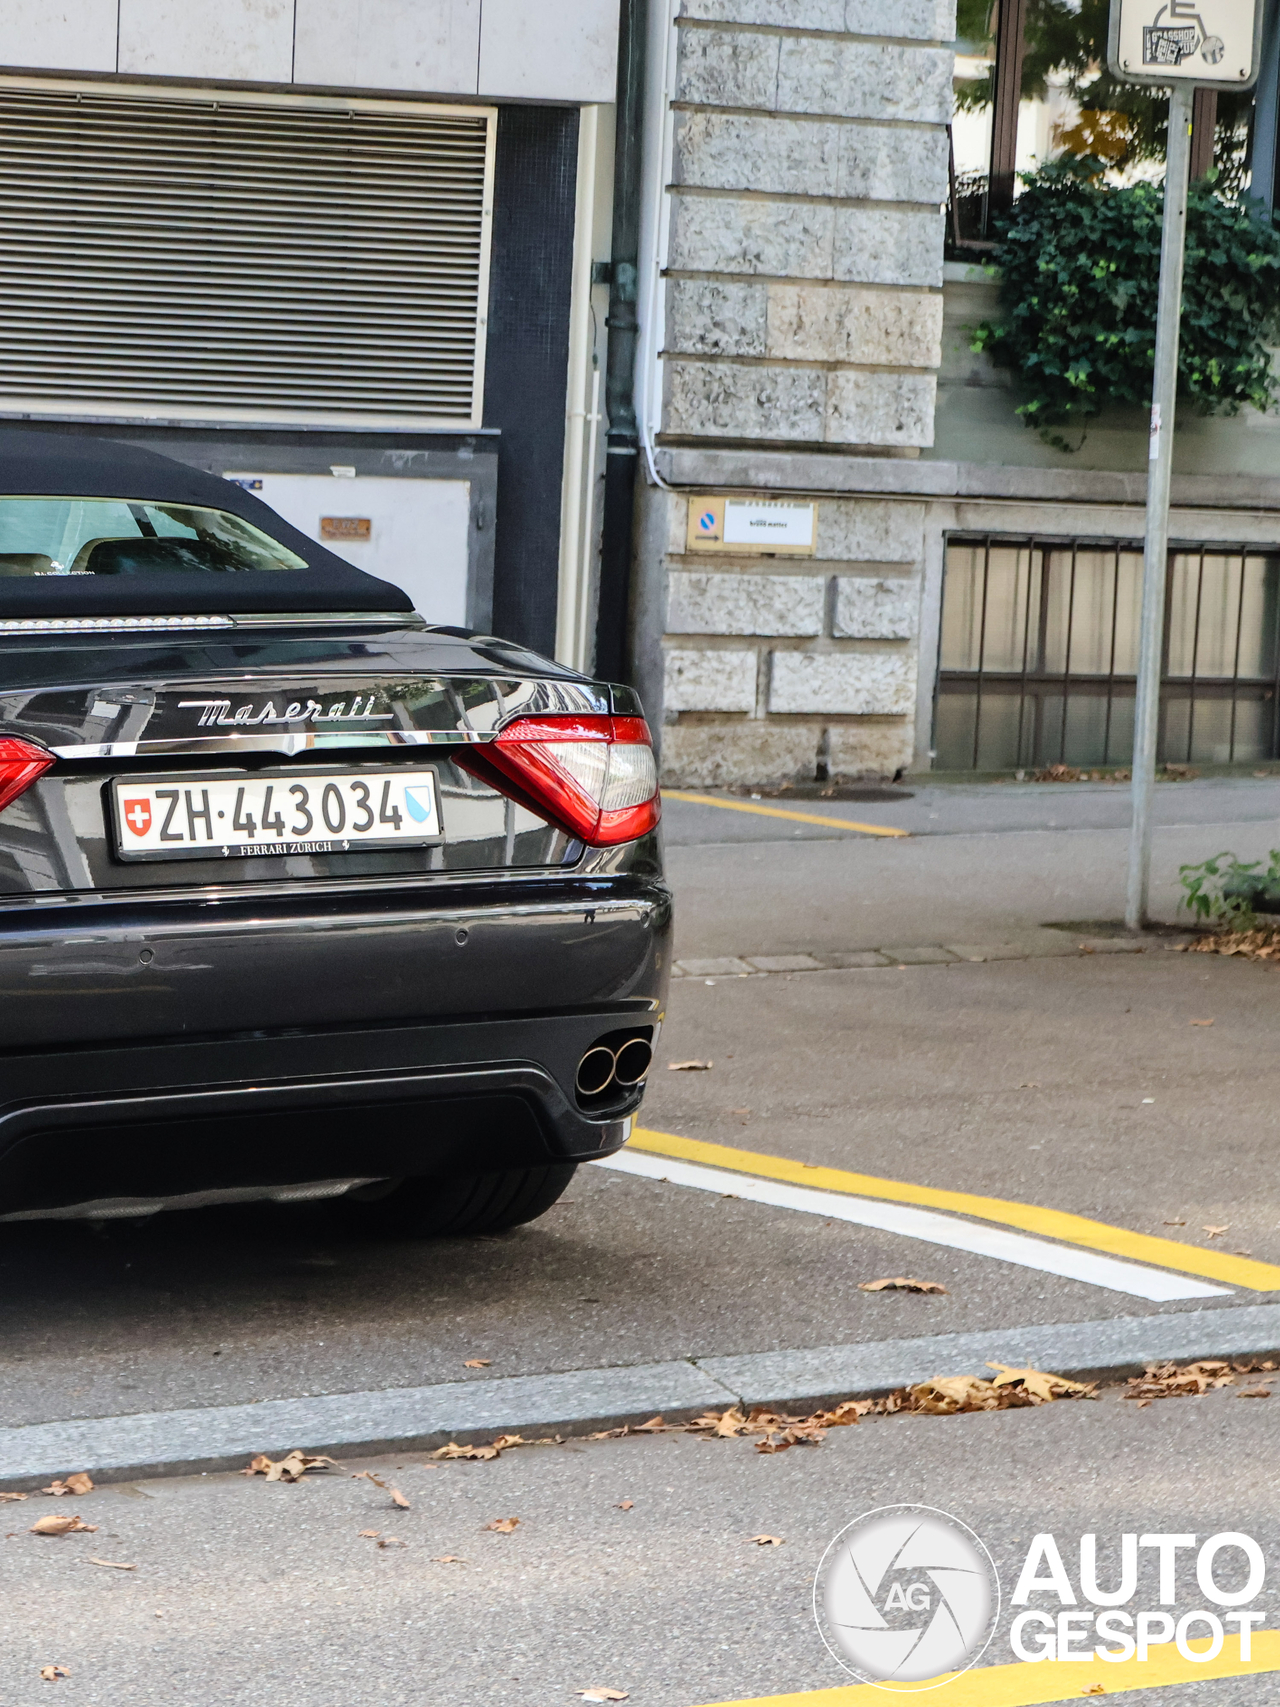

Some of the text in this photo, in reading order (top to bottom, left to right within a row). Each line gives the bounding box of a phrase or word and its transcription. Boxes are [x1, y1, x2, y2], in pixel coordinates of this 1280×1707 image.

[178, 696, 394, 727] Maserati
[240, 841, 332, 856] FERRARI ZÜRICH
